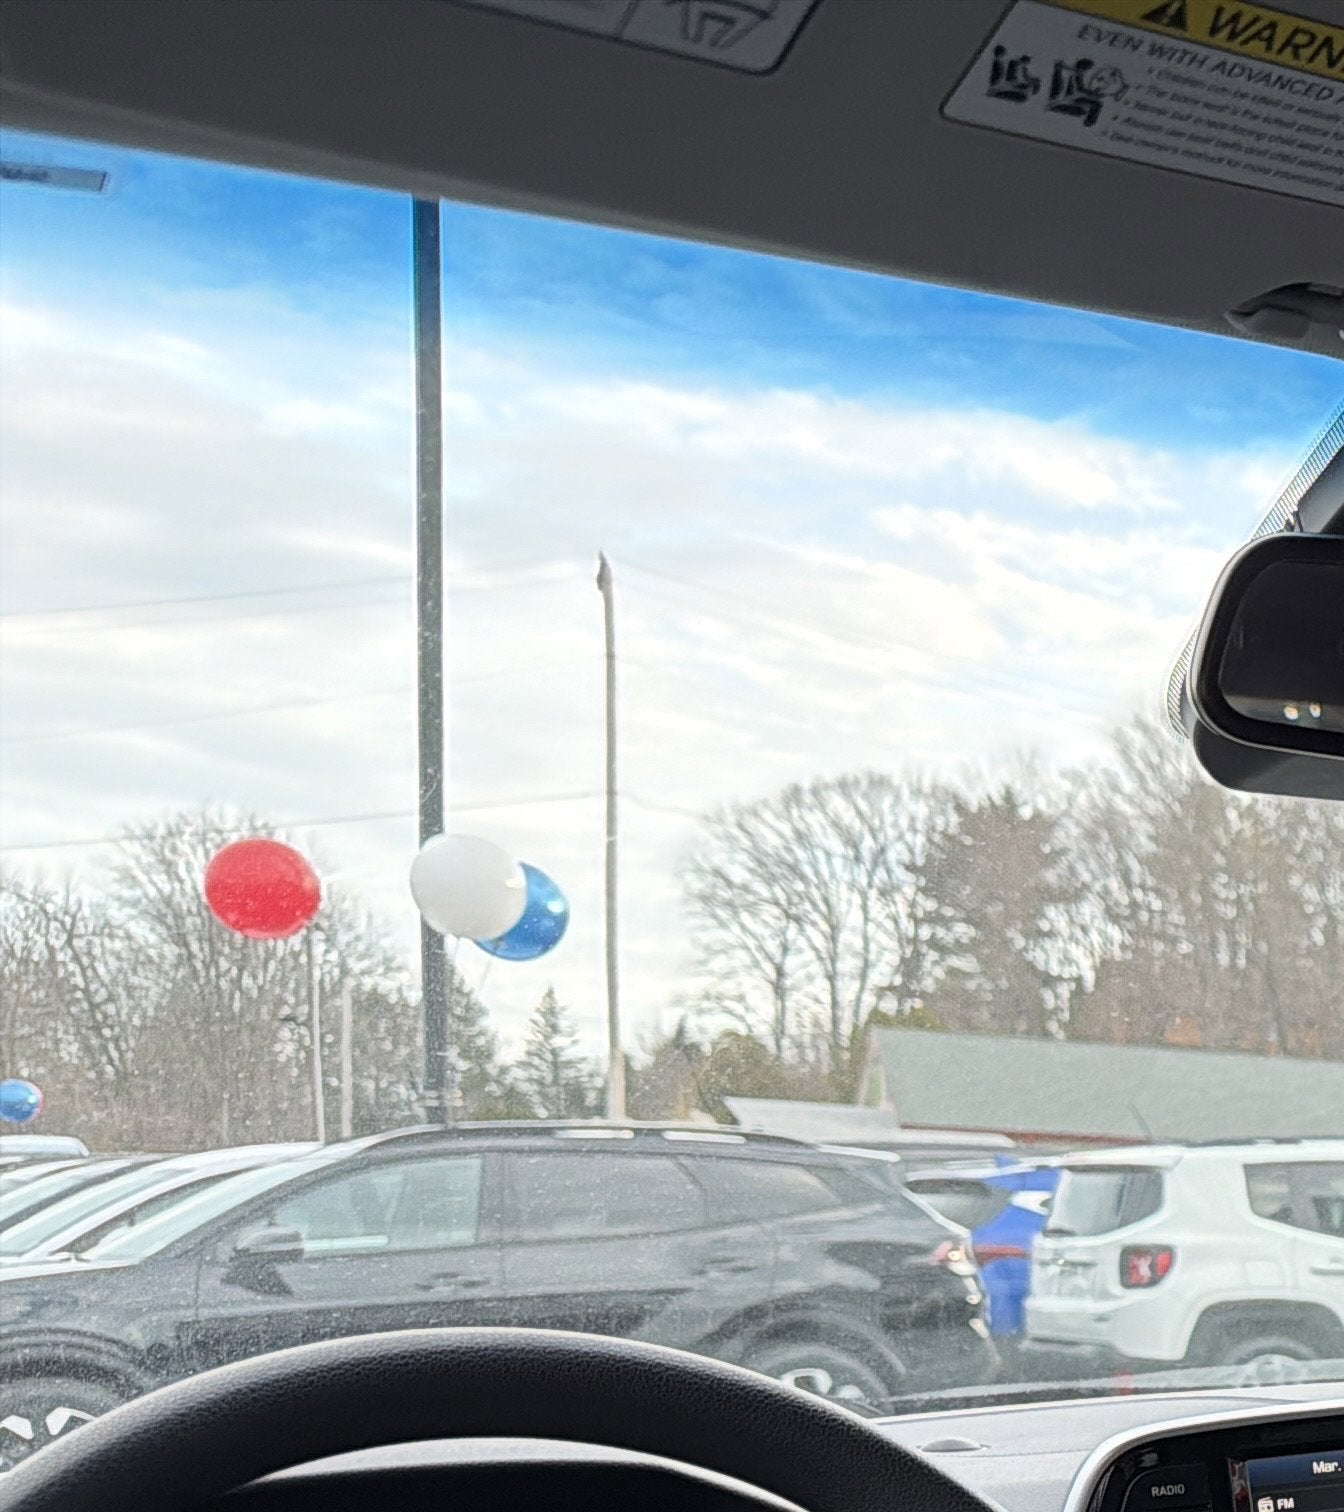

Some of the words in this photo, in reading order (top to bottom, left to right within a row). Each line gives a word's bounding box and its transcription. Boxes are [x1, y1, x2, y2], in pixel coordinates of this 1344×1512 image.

[1078, 23, 1142, 52] EVEN
[1147, 42, 1209, 69] WITH
[1211, 57, 1334, 101] ADVANCED
[1312, 1461, 1342, 1474] Mar.
[1151, 1484, 1185, 1498] RADIO
[1277, 1497, 1295, 1510] FM
